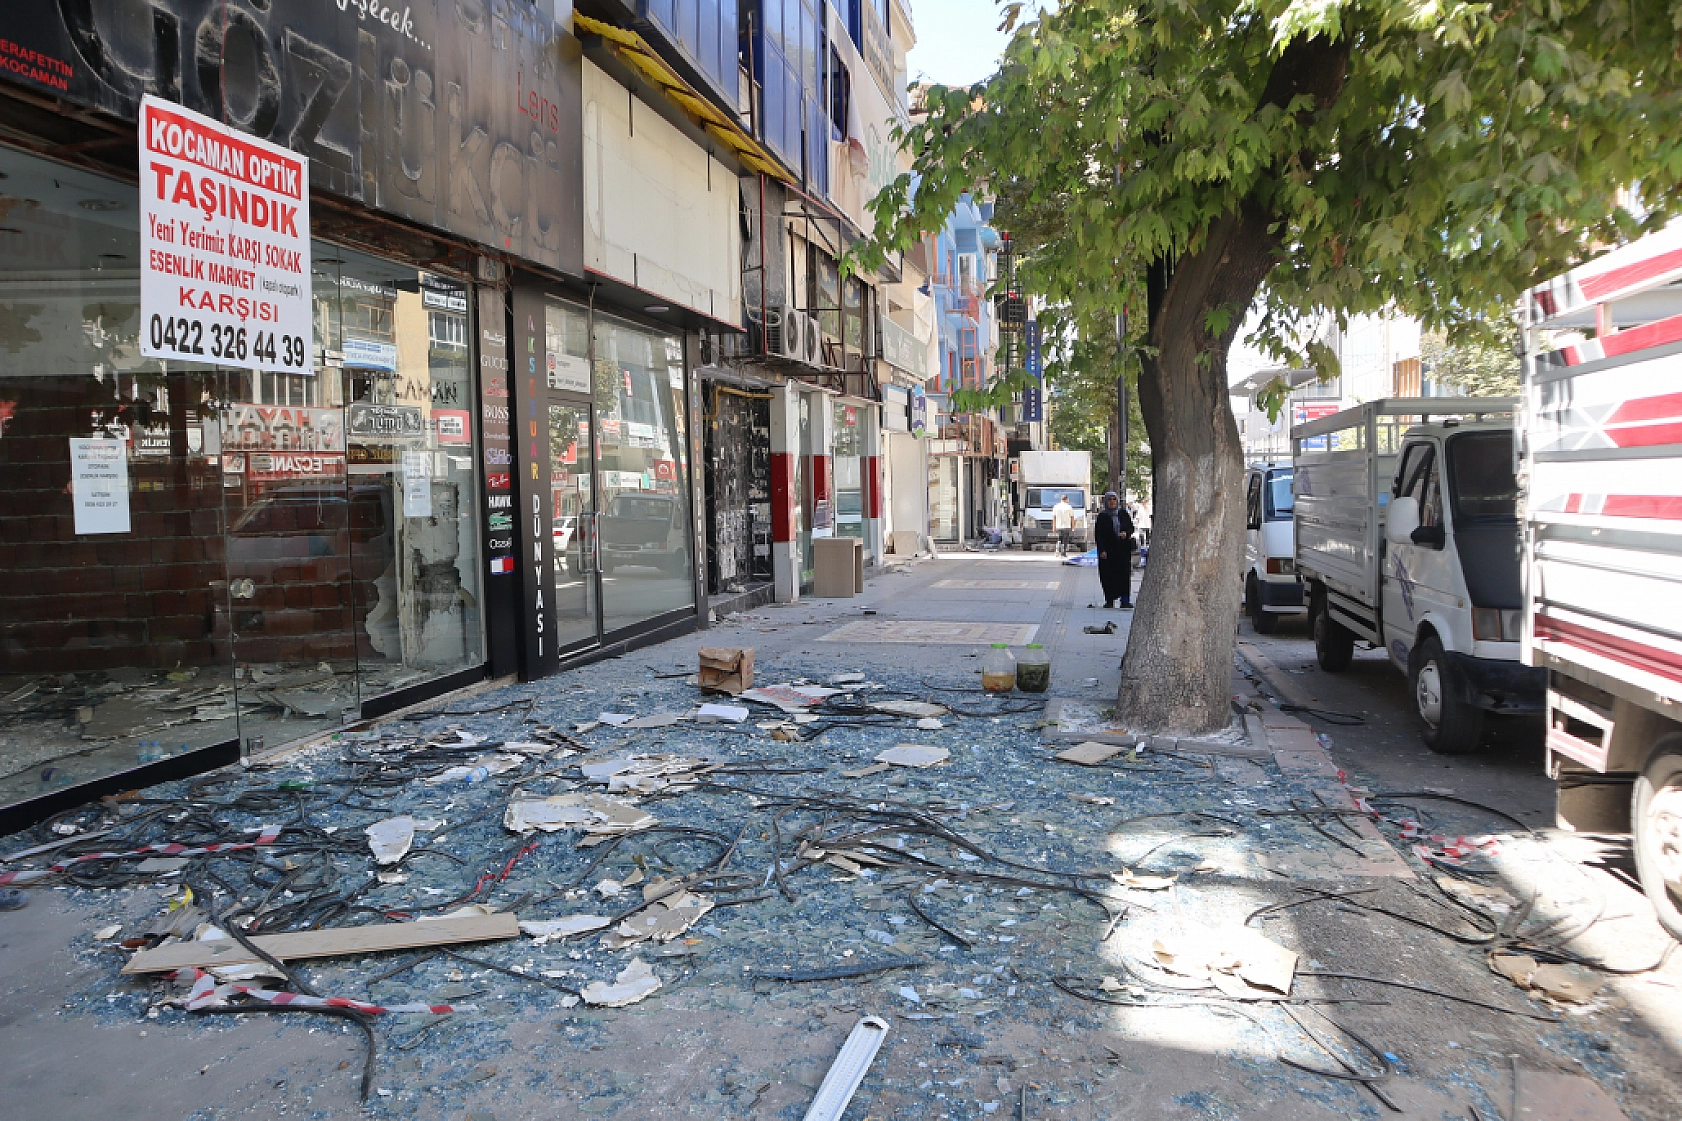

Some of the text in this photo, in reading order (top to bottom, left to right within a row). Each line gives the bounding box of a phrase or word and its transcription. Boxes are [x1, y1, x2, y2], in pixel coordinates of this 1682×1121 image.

[0, 54, 68, 91] KOCAMAN
[517, 71, 559, 133] Lens
[151, 117, 298, 196] KOCAMAN OPTİK
[150, 161, 298, 238] TAŞINDIK
[148, 212, 302, 274] Yeni Yerimiz KARŞI SOKAK
[150, 248, 204, 280] ESENLİK
[209, 261, 256, 291] MARKET
[179, 285, 278, 323] KARŞISI
[150, 313, 204, 356] 0422
[211, 323, 248, 361] 326
[253, 330, 277, 365] 44
[282, 334, 305, 367] 39
[483, 404, 509, 420] BOSS
[532, 493, 544, 658] DÜNYASI
